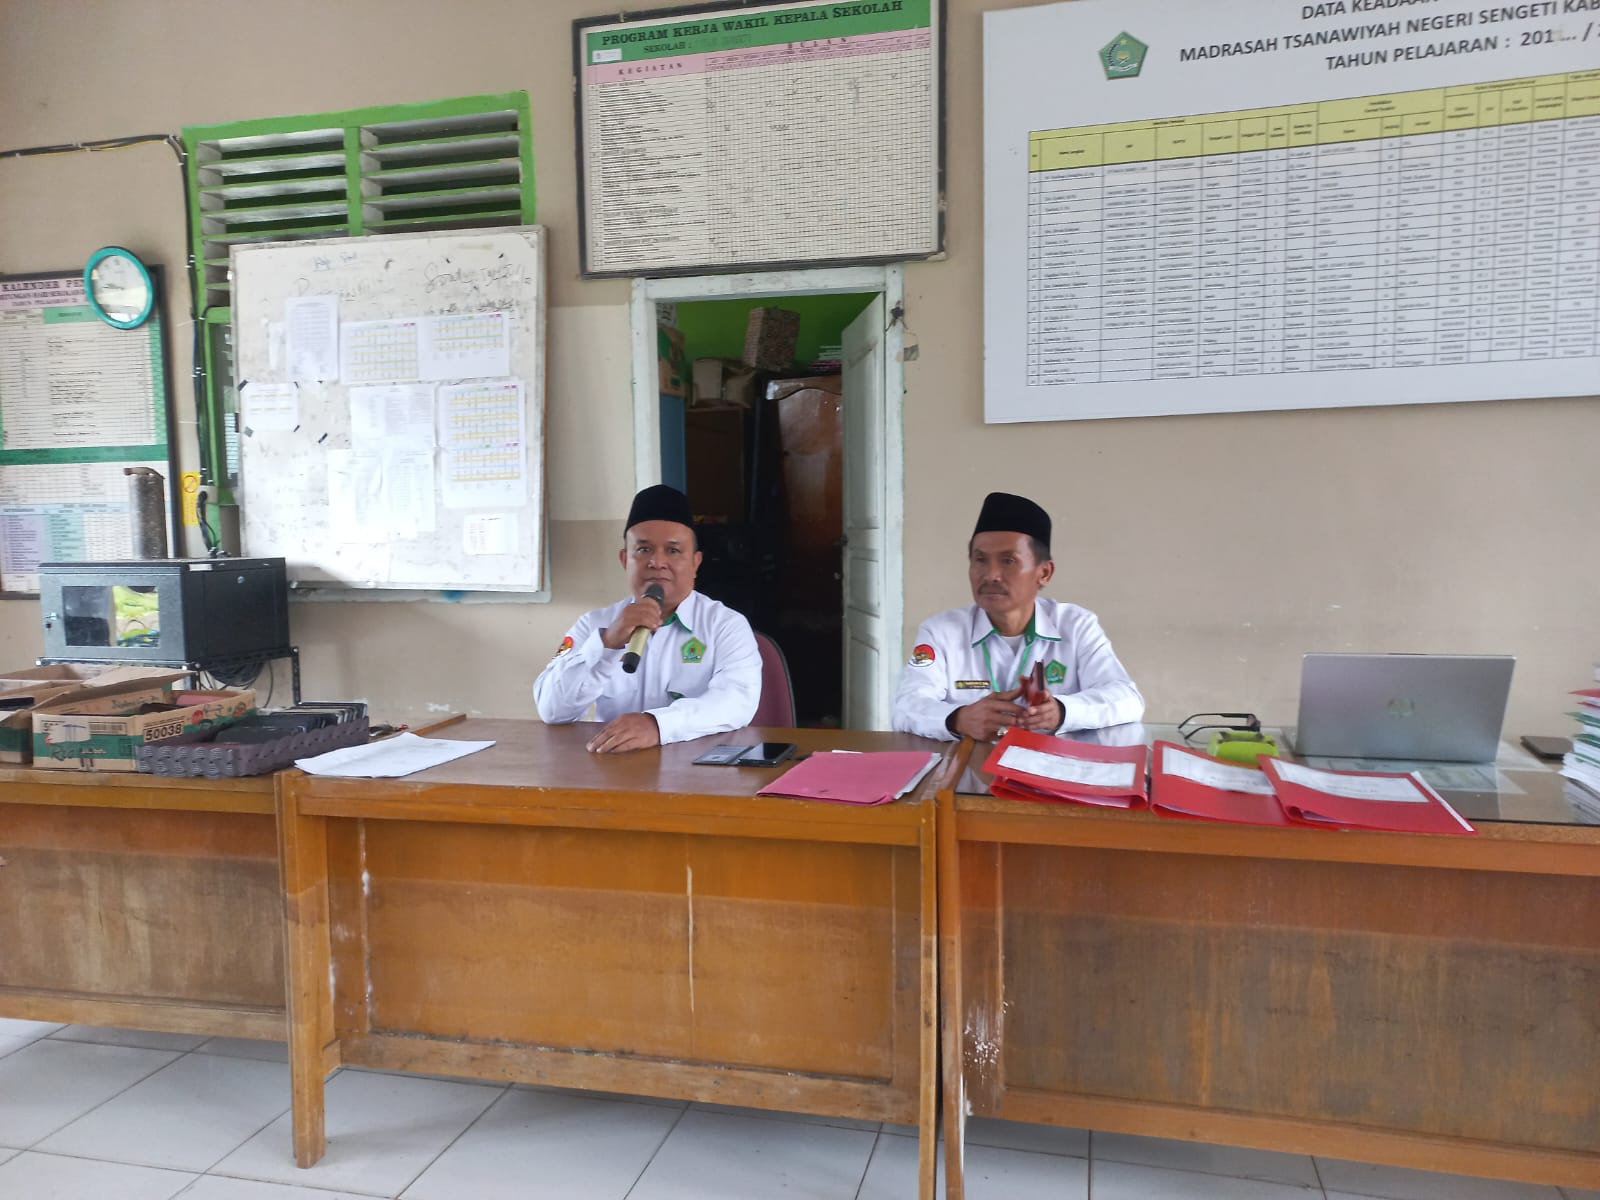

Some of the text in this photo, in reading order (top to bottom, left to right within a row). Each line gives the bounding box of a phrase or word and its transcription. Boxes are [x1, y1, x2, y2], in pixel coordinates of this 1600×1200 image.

[602, 1, 903, 46] PROGRAM KERJA WAKIL KEPALA SEKOLAH
[1302, 1, 1346, 20] DATA
[1180, 37, 1278, 62] MADRASAH
[1283, 21, 1400, 50] TSANAWIYAH
[1406, 12, 1473, 34] NEGERI
[1479, 1, 1557, 25] SENGETI
[643, 41, 686, 54] SEKOLAH
[1326, 50, 1387, 71] TAHUN
[1393, 36, 1498, 62] PELAJARAN
[144, 723, 182, 741] 50038
